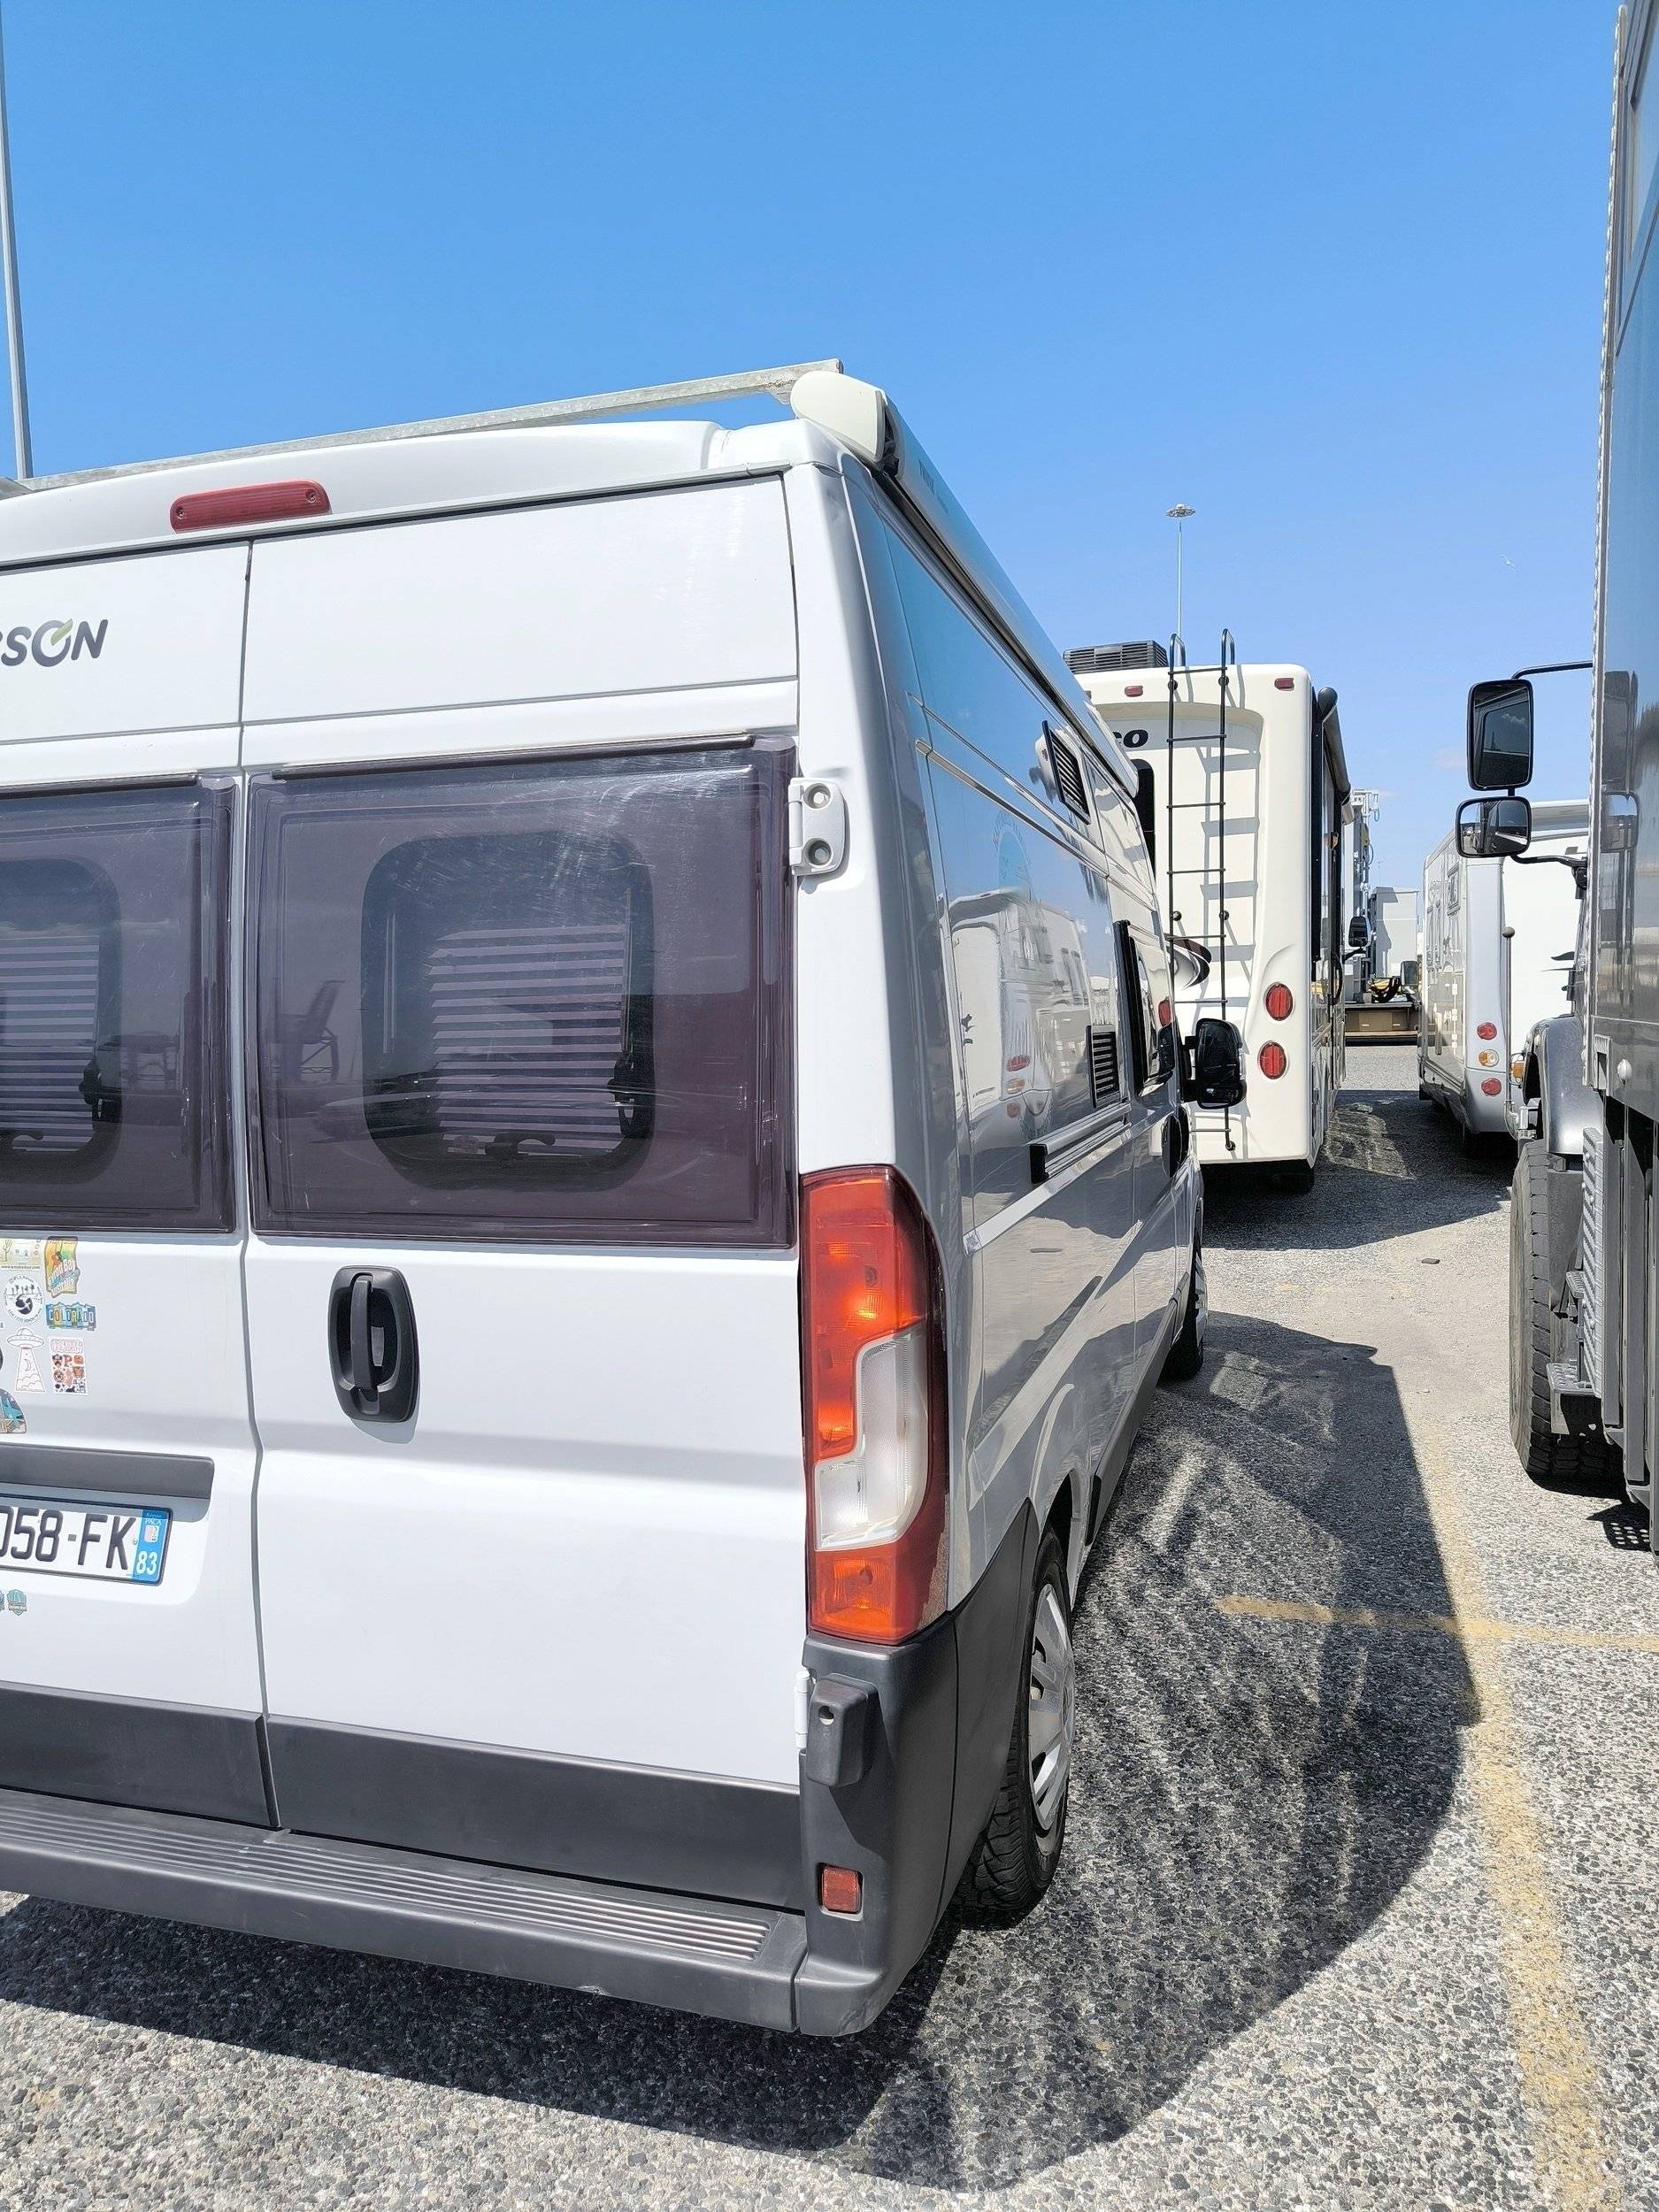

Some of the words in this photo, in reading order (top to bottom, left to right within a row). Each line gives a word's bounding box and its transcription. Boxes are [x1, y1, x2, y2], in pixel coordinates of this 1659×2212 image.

[0, 618, 109, 667] SON
[50, 1309, 94, 1324] COLORADO
[136, 1550, 158, 1575] 83
